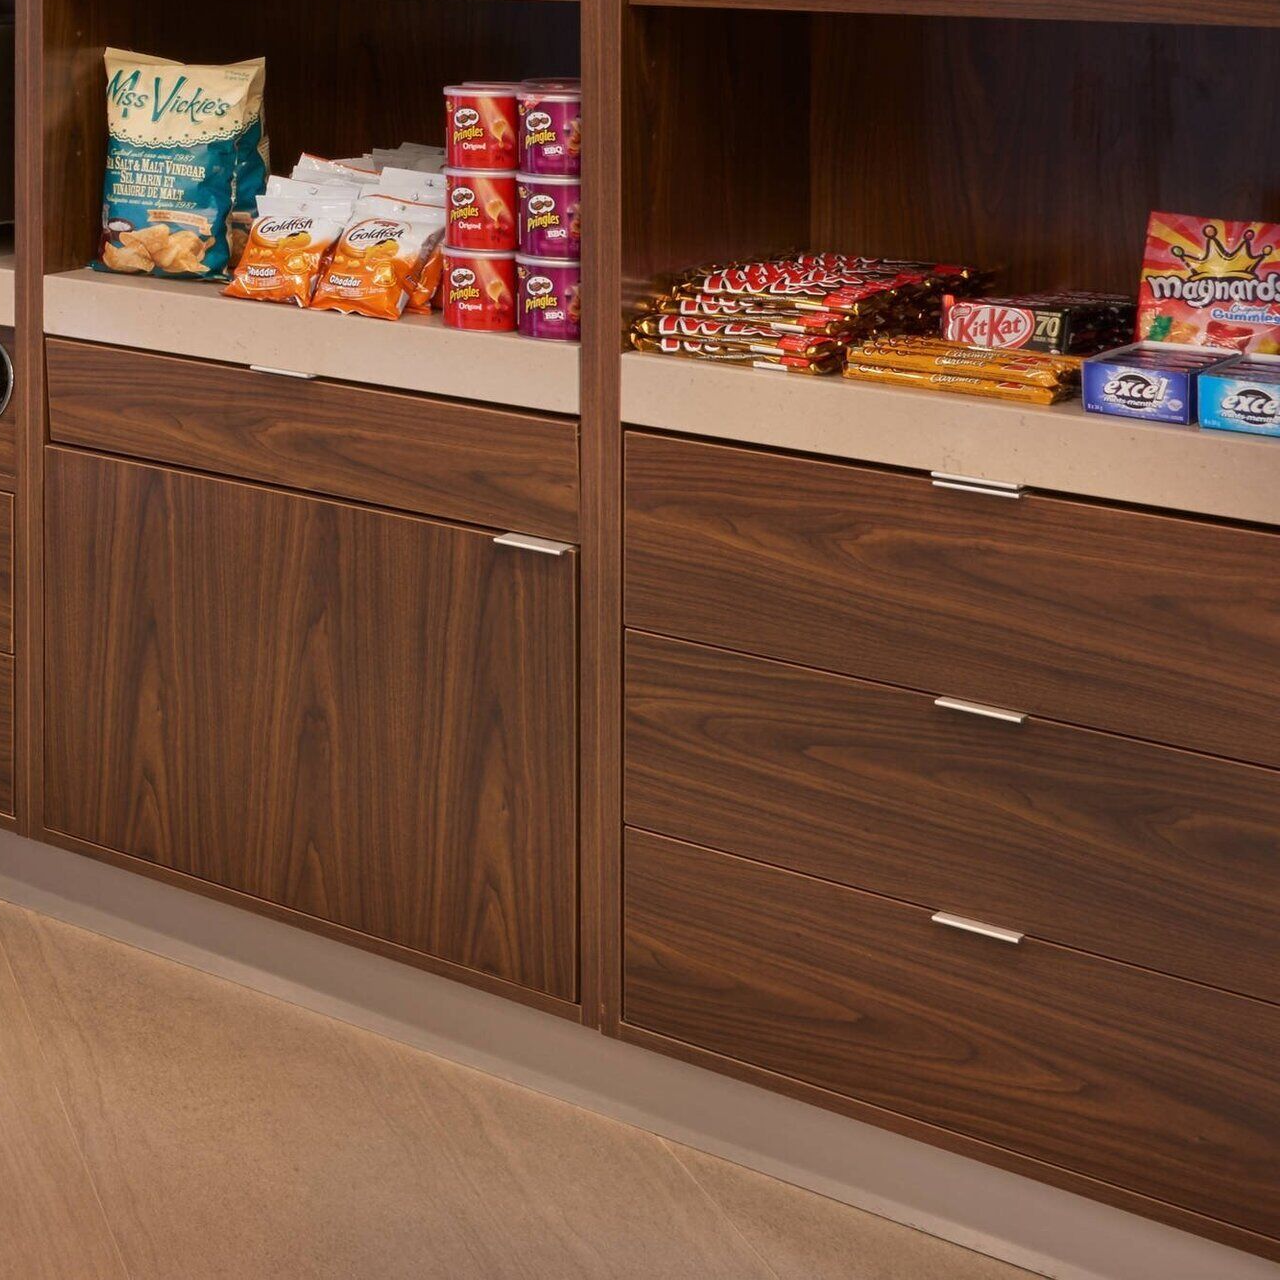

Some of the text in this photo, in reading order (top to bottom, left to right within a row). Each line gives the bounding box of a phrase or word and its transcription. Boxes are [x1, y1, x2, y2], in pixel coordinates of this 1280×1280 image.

[107, 69, 231, 125] Miss Vickie's
[453, 127, 485, 145] Pringles
[525, 131, 557, 149] Pringles
[544, 145, 563, 155] BBQ
[115, 156, 134, 171] SALT
[141, 159, 165, 173] MALT
[165, 160, 206, 179] VINEGAR
[120, 170, 176, 187] SEL MARIN ET
[113, 183, 184, 200] VINAIGRE DE MALT
[450, 207, 479, 223] Pringles
[527, 212, 560, 233] Pringles
[260, 218, 314, 234] Goldfish
[348, 226, 404, 243] Goldfish
[547, 229, 567, 239] BBQ
[329, 274, 362, 287] Cheddar
[449, 287, 480, 305] Pringles
[525, 294, 558, 314] Pringles
[544, 310, 564, 320] BBQ
[1035, 316, 1060, 337] 70
[1103, 377, 1168, 401] excel
[1220, 393, 1280, 417] exce
